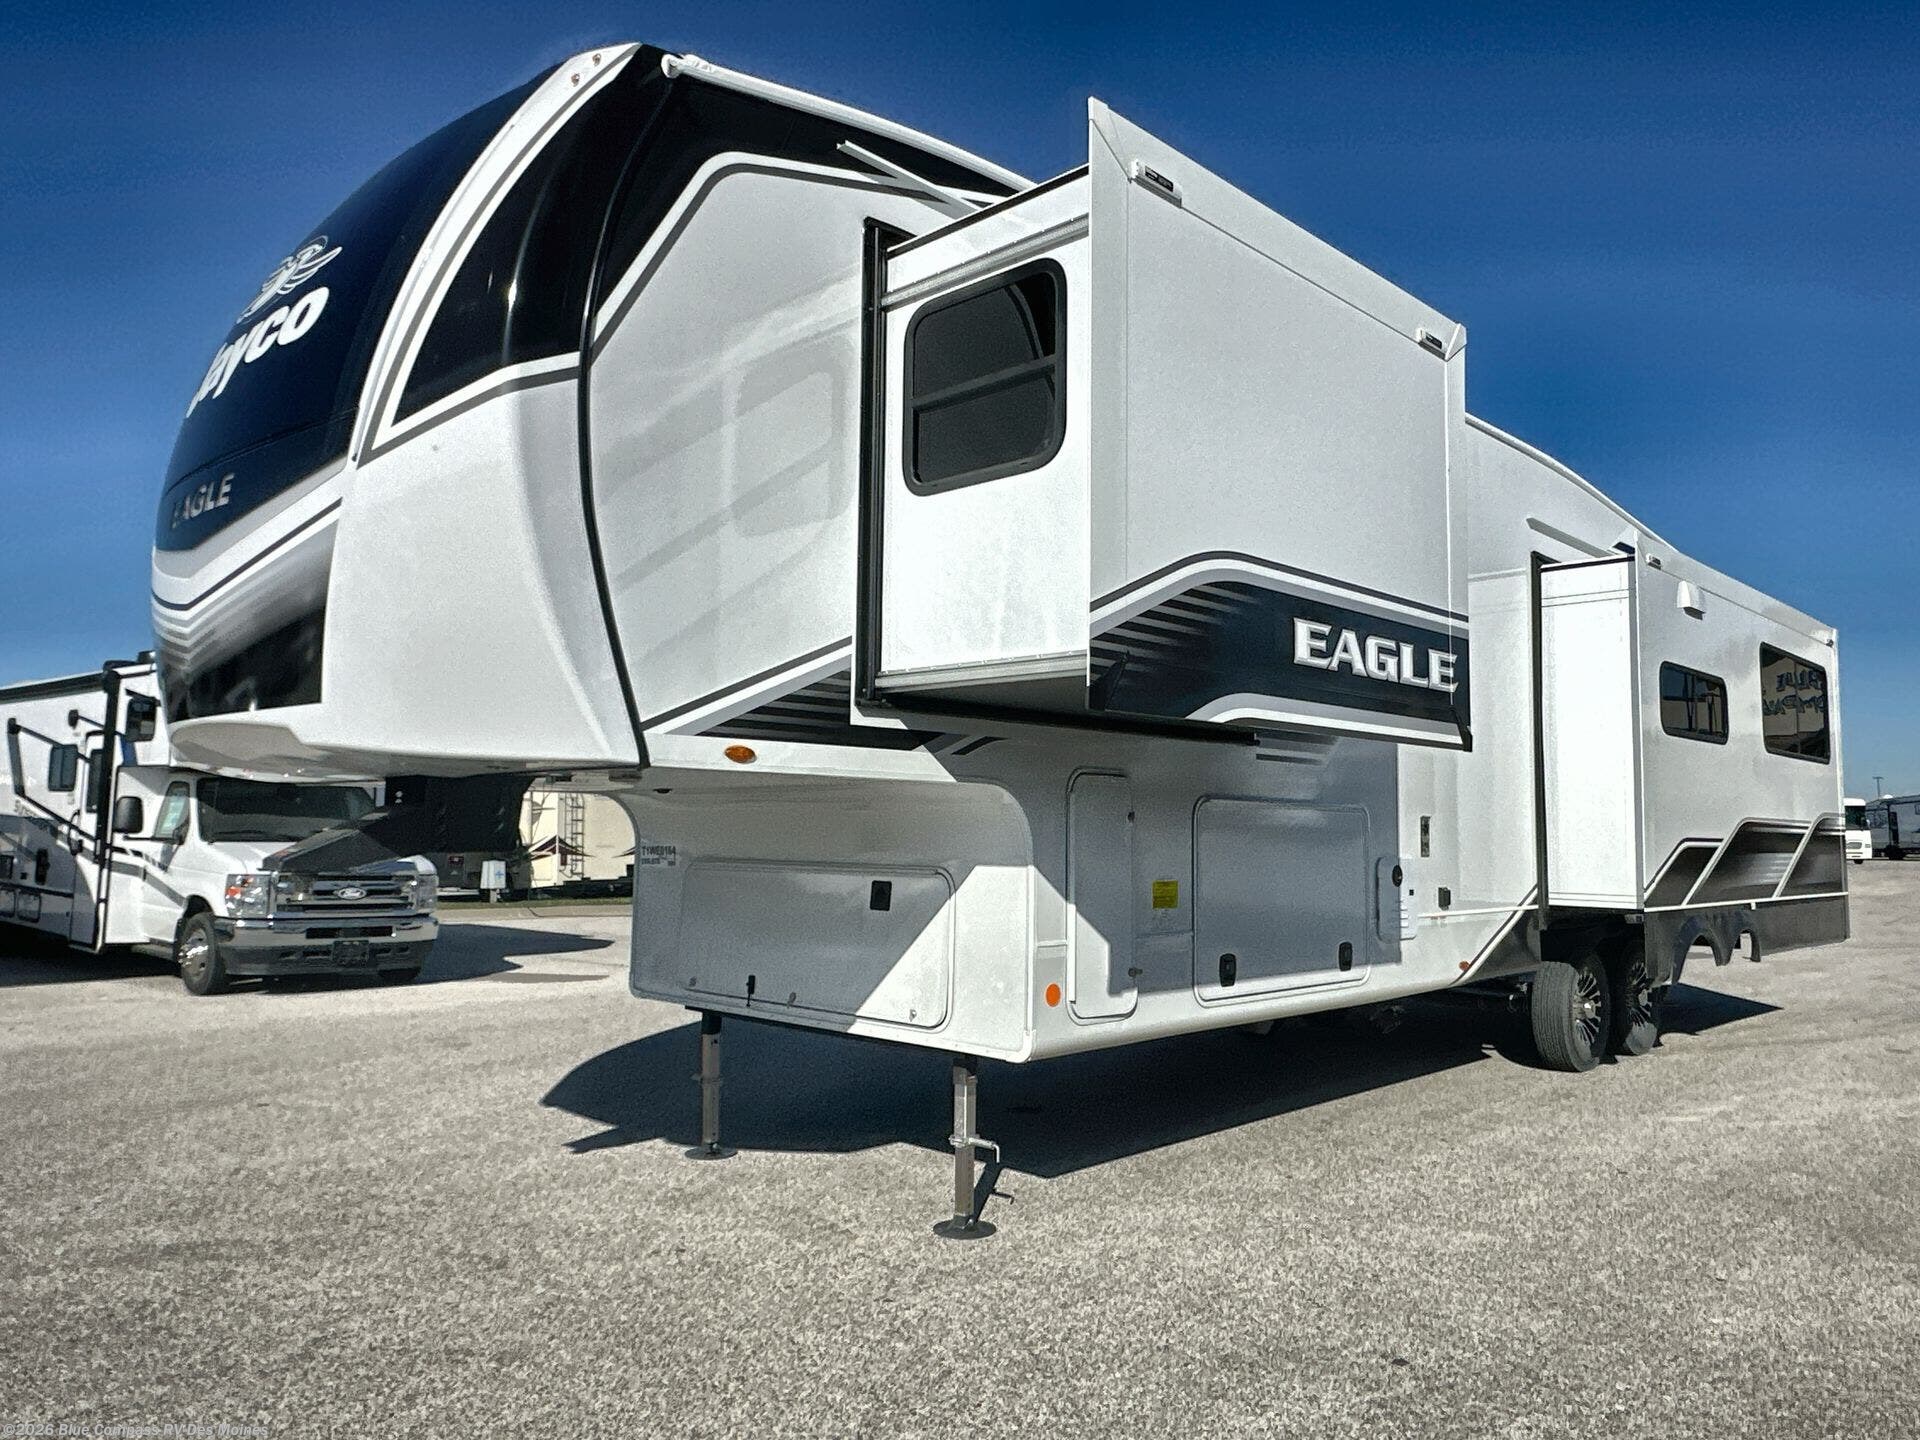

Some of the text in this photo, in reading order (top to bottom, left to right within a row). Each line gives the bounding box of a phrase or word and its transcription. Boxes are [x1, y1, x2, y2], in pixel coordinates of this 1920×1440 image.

[186, 286, 330, 418] ayco
[172, 472, 236, 529] AGLE
[1293, 617, 1459, 692] EAGLE
